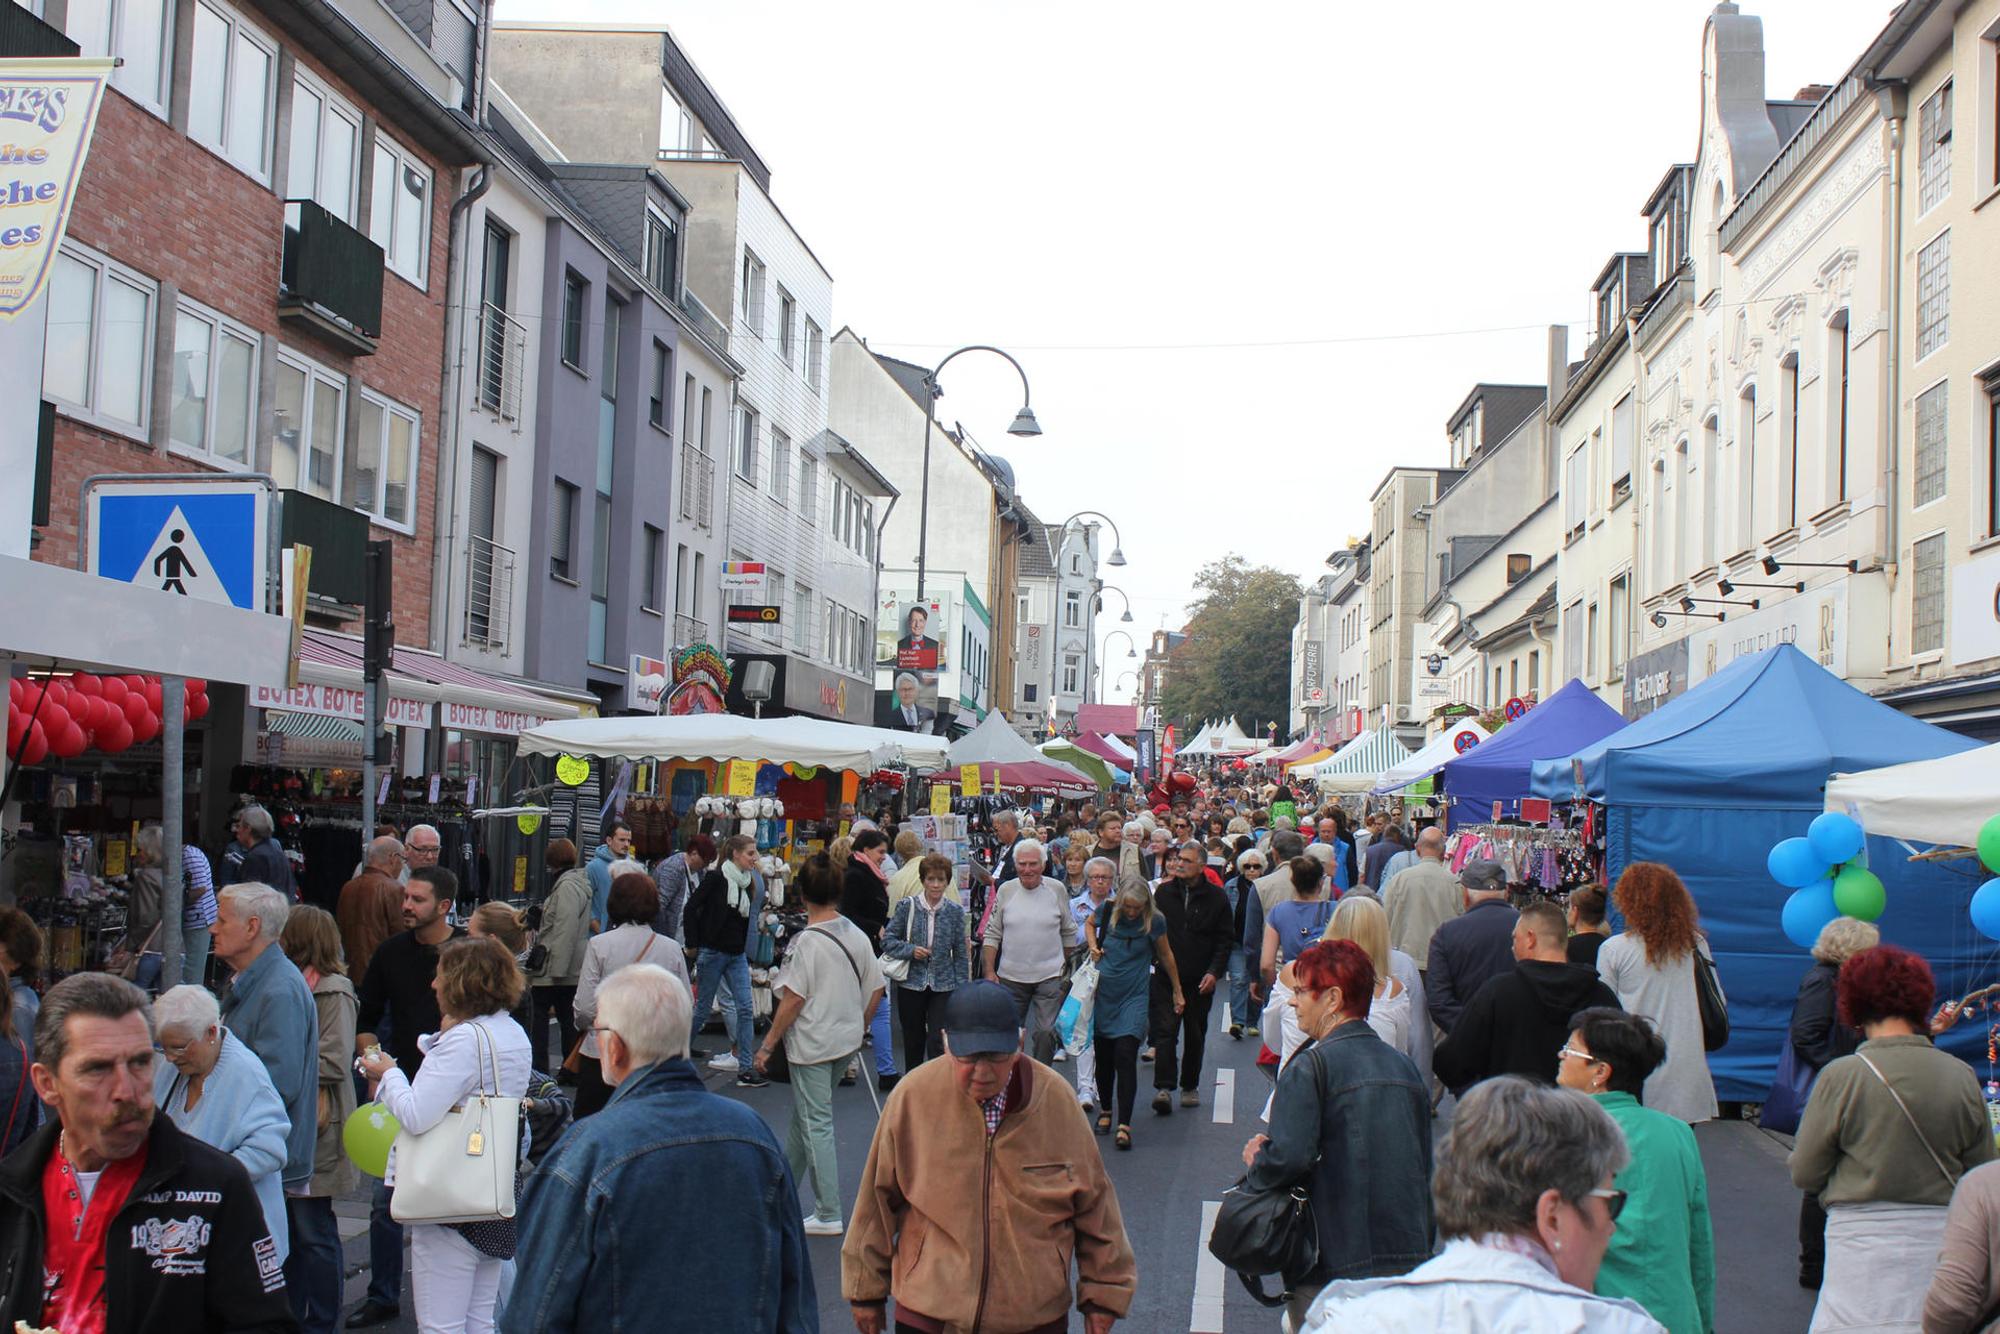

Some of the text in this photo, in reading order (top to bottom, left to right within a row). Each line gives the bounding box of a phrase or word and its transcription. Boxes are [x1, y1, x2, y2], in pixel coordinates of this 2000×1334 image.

[258, 683, 424, 722] BOTEX BOTE OTEX
[450, 703, 488, 727] BOTEX
[495, 710, 528, 730] BOTEX
[175, 1191, 222, 1204] DAVID
